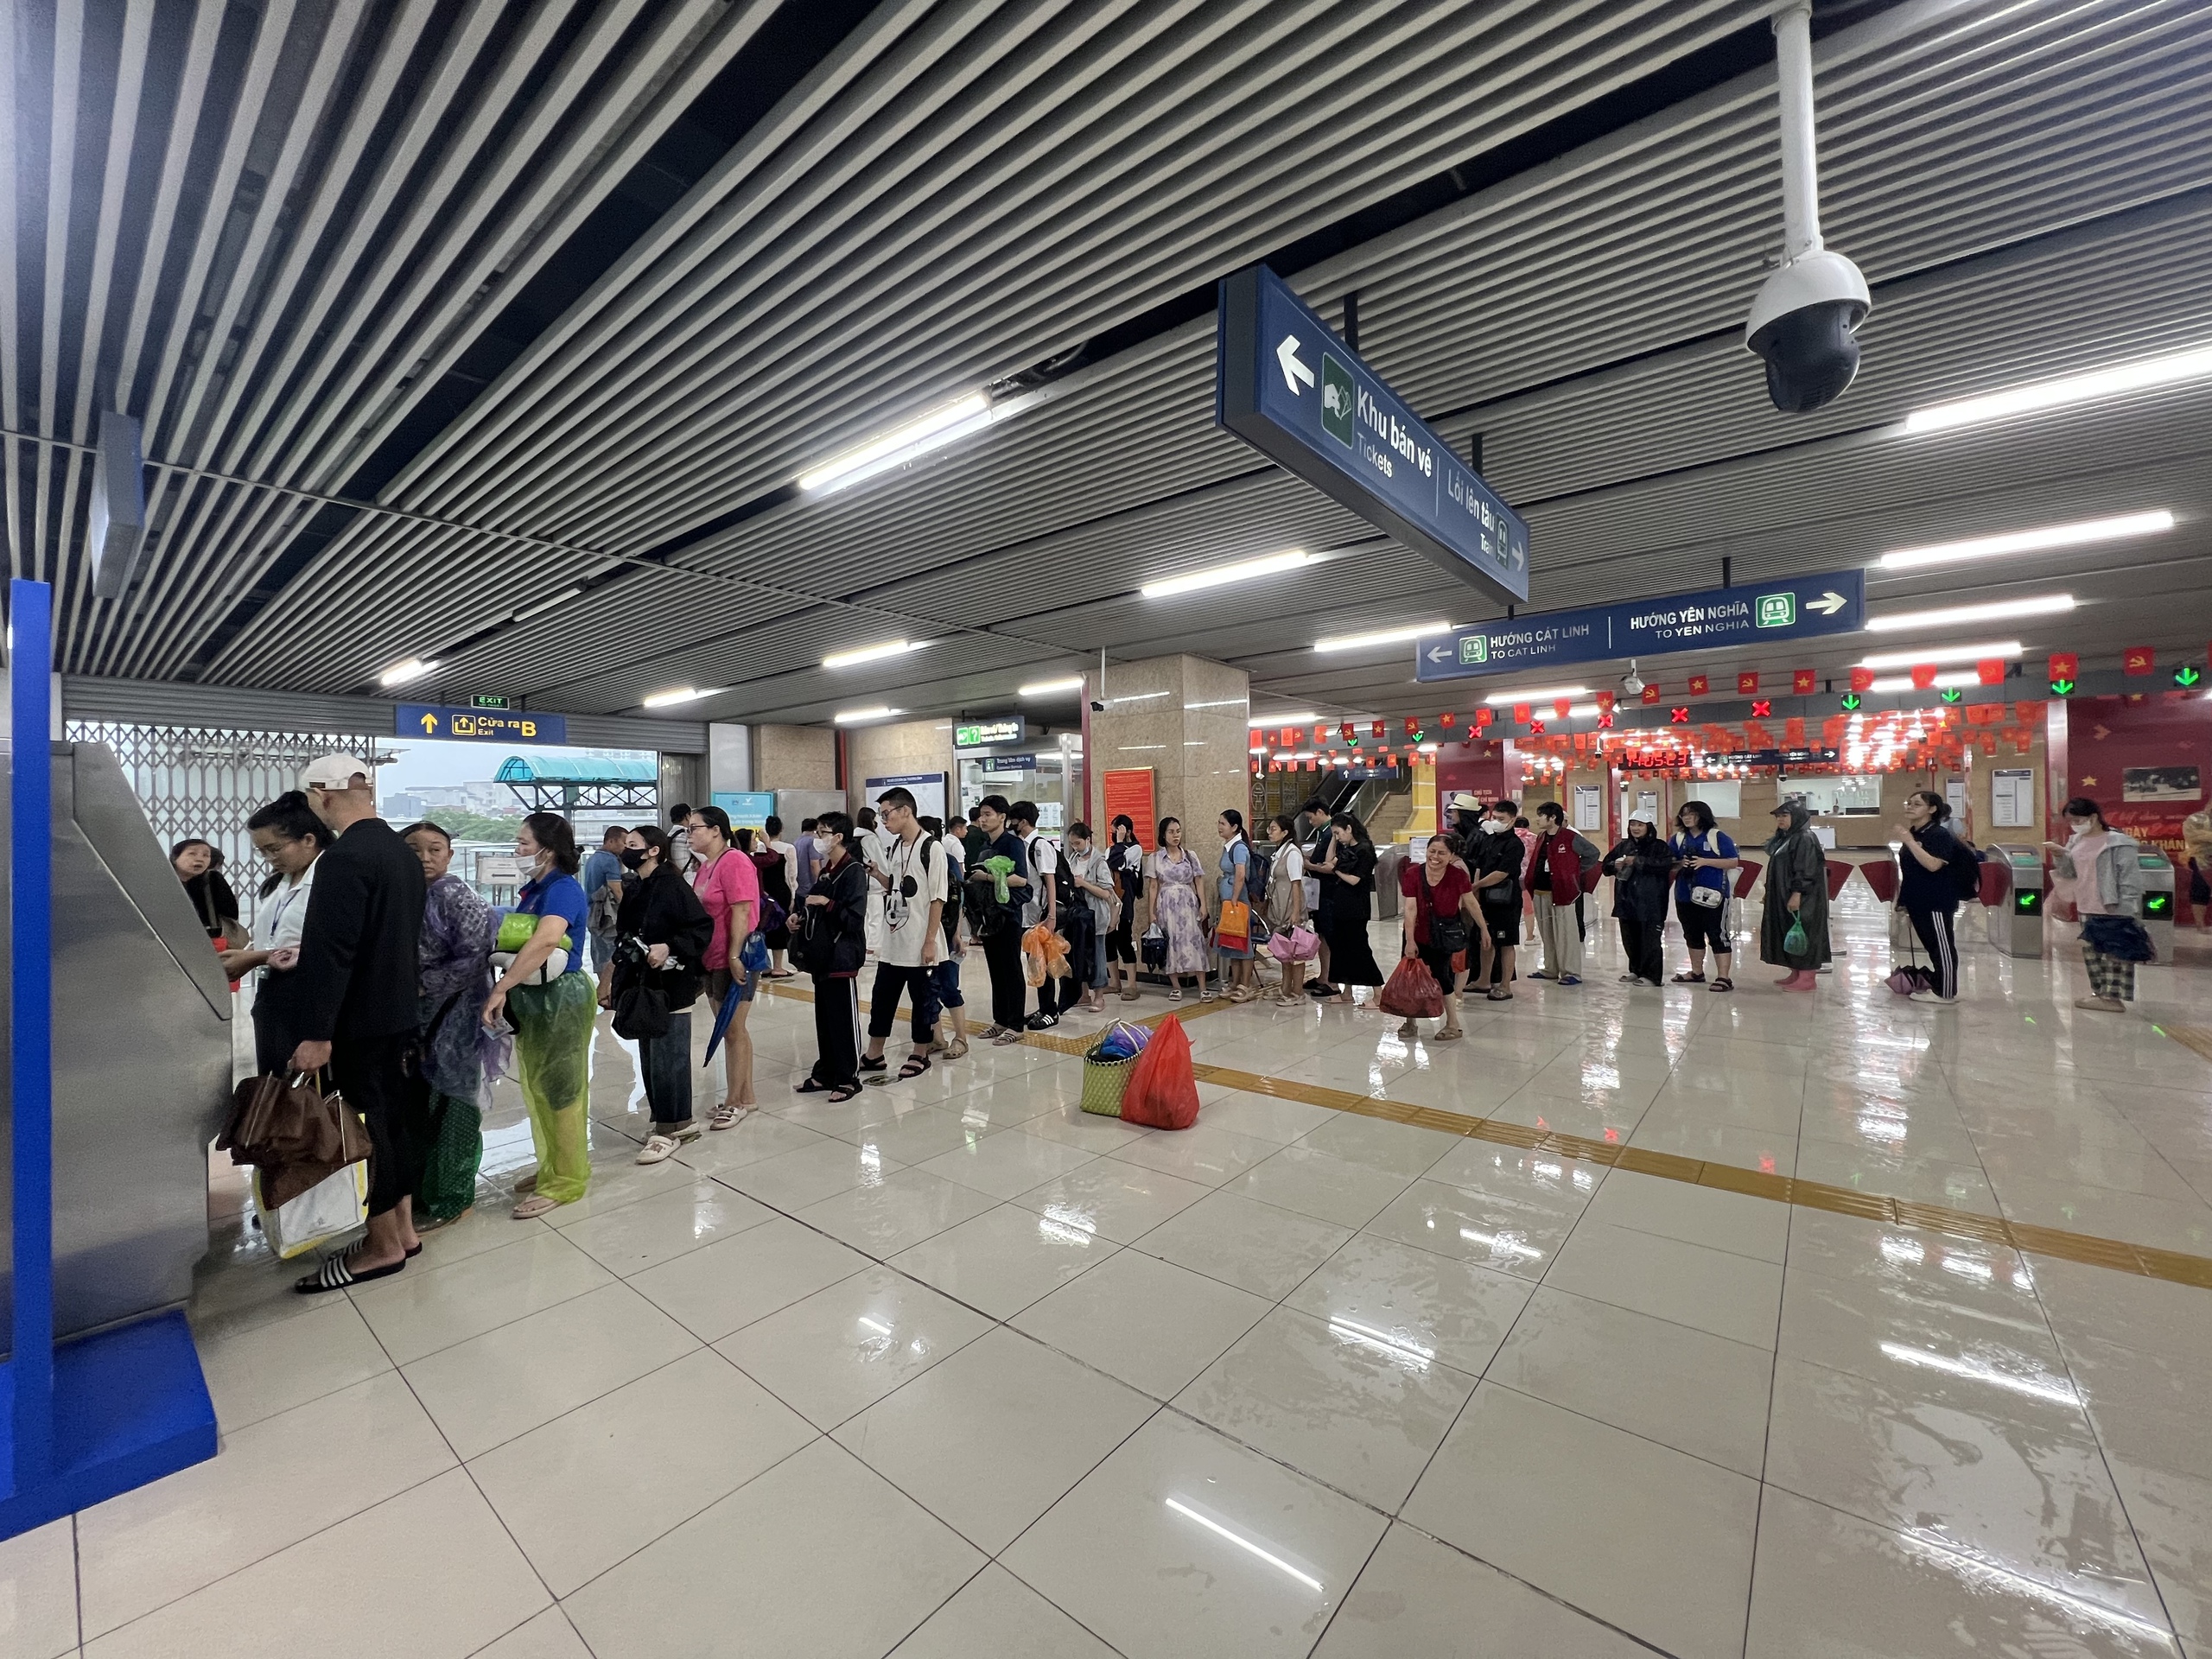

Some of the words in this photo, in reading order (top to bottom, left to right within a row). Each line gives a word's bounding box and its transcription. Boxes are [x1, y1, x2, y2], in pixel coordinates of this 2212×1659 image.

[1357, 385, 1387, 440] Khu
[1390, 415, 1414, 463] bán
[1417, 447, 1432, 478] vé
[1357, 432, 1392, 478] Tickets
[1448, 468, 1464, 505] Lối
[1465, 485, 1479, 519] lên
[1481, 501, 1495, 532] tàu
[1630, 612, 1676, 630] HƯỚNG
[1679, 607, 1704, 623] YÊN
[1707, 601, 1749, 619] NGHĨA
[1490, 632, 1533, 648] HƯỚNG
[1535, 626, 1559, 642] CÁT
[1562, 624, 1590, 639] LINH
[1656, 629, 1673, 639] TO
[1675, 625, 1702, 637] YEN
[1705, 620, 1750, 633] NGHIA
[1491, 650, 1505, 659] TO
[1508, 647, 1528, 657] CAT
[1530, 644, 1556, 655] LINH
[478, 716, 504, 728] Cửa
[508, 720, 520, 728] ra
[521, 721, 537, 737] B
